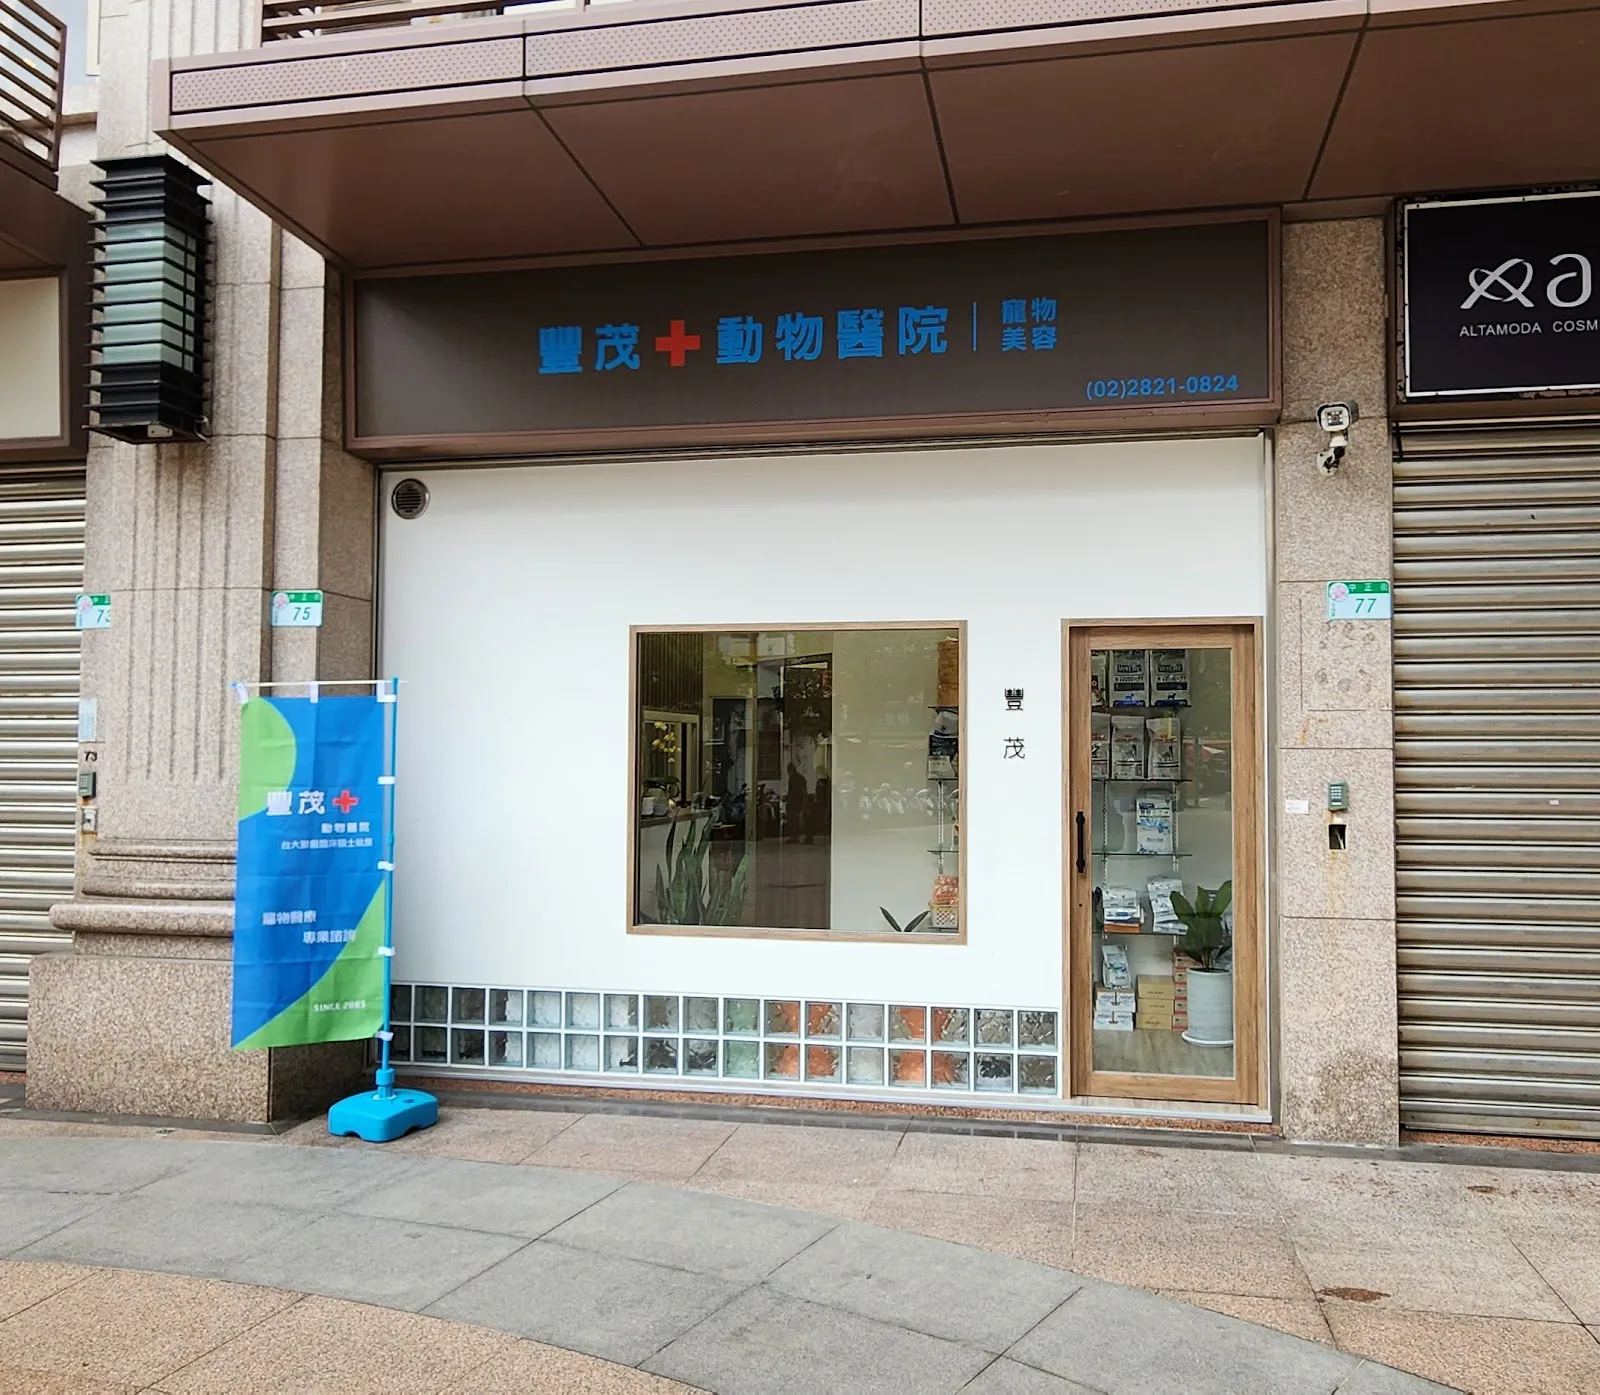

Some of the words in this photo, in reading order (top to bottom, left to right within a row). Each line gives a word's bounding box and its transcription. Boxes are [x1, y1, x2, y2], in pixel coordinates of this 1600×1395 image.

[1002, 297, 1057, 324] 寵物
[538, 323, 641, 375] 豐茂
[716, 304, 949, 365] 動物醫院
[1002, 326, 1058, 352] 美容
[1459, 321, 1542, 337] ALTAMODA
[1086, 374, 1239, 400] (02)2821-0824
[293, 606, 311, 621] 75
[1355, 598, 1377, 613] 77
[1003, 688, 1025, 759] 豐茂
[266, 790, 325, 816] 豐茂
